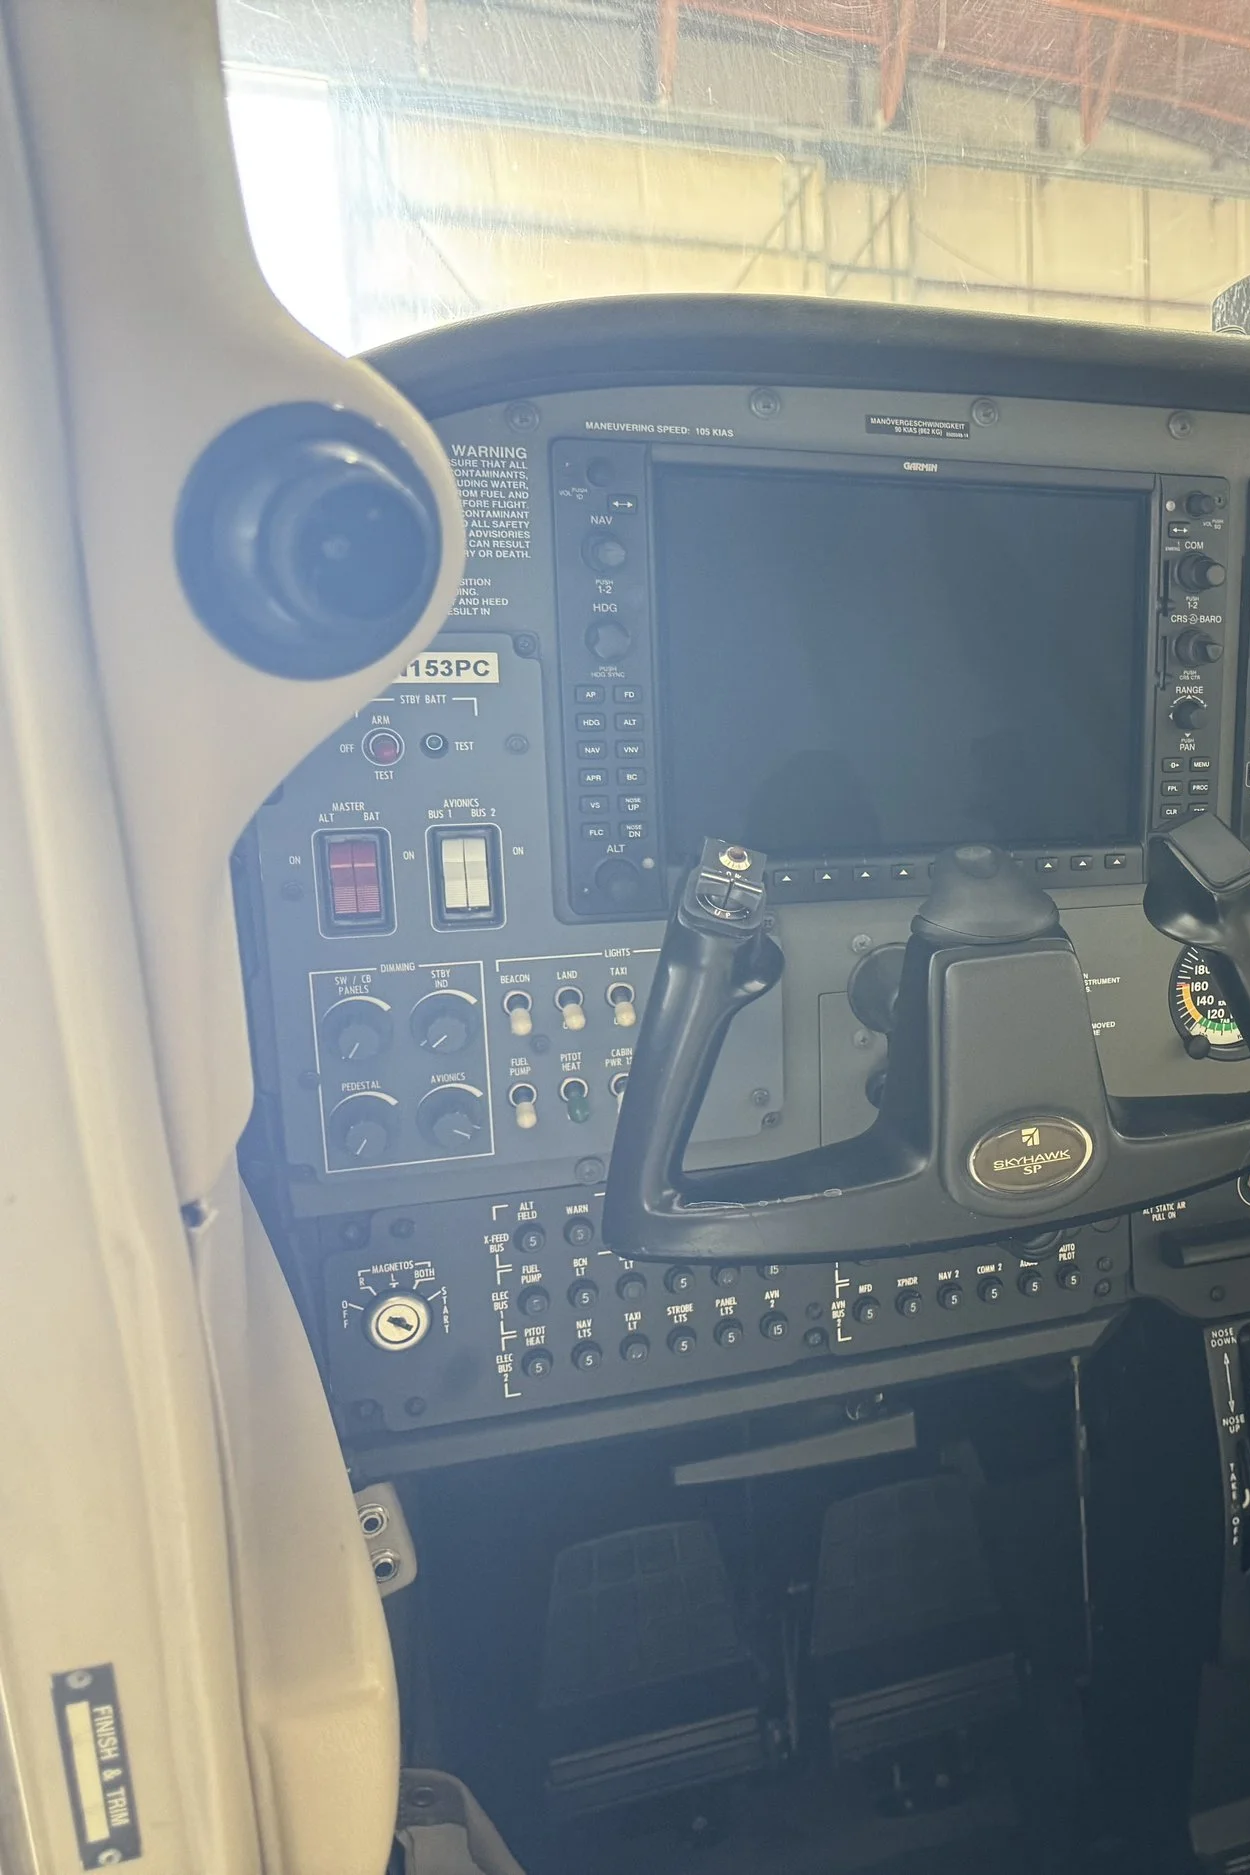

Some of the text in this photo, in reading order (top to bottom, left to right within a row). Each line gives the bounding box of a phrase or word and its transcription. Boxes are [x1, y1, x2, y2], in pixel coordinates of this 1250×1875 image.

[585, 421, 734, 438] MANEUVERING SPEED: 105 KIAS
[452, 444, 527, 459] WARNING
[481, 459, 507, 468] THAT
[509, 460, 528, 469] ALL
[903, 462, 938, 472] GARMIN
[491, 481, 529, 490] WATER,
[481, 490, 529, 499] FUEL AND
[492, 501, 529, 509] FLIGHT.
[472, 520, 530, 529] ALL SAFETY
[591, 516, 613, 525] NAV
[469, 540, 531, 549] CAN RESULT
[479, 550, 492, 558] OR
[496, 550, 531, 559] DEATH.
[459, 598, 508, 606] AND HEED
[480, 608, 490, 616] IN
[593, 603, 617, 612] HDG
[1171, 615, 1222, 623] CRS BARO
[400, 694, 447, 705] STBY BATT
[372, 715, 390, 725] ARM
[339, 744, 355, 752] OFF
[454, 742, 474, 751] TEST
[374, 771, 394, 780] TEST
[332, 802, 365, 812] MASTER
[443, 798, 480, 808] AVIONICS
[318, 812, 380, 823] ALT BAT
[428, 810, 444, 819] BUS
[471, 808, 496, 818] BUS 2
[512, 846, 524, 855] ON
[607, 844, 626, 853] ALT
[289, 856, 301, 864] ON
[403, 851, 415, 860] ON
[604, 948, 631, 958] LIGHTS
[380, 962, 415, 973] DIMMING
[610, 966, 628, 975] TAXI
[431, 969, 450, 978] STBY
[556, 970, 577, 980] LAND
[335, 976, 349, 985] SW
[359, 975, 372, 984] CB
[435, 979, 448, 989] IND
[500, 974, 530, 984] BEACON
[338, 985, 369, 995] PANELS
[1191, 981, 1208, 992] 160
[1196, 995, 1214, 1006] 140
[1208, 1009, 1224, 1019] 120
[560, 1052, 582, 1062] PITOT
[611, 1048, 632, 1057] CABIN
[511, 1058, 528, 1066] FUEL
[562, 1062, 582, 1071] HEAT
[605, 1058, 622, 1067] PWR
[510, 1067, 531, 1076] PUMP
[430, 1072, 466, 1083] AVIONICS
[341, 1080, 381, 1091] PEDESTAL
[994, 1150, 1070, 1169] SKYHAWK
[1024, 1164, 1042, 1175] SP
[520, 1201, 534, 1211] ALT
[566, 1204, 588, 1214] WARN
[1156, 1203, 1174, 1213] STATIC
[1177, 1201, 1186, 1209] AIR
[517, 1211, 537, 1221] FIELD
[1152, 1214, 1165, 1222] PULL
[484, 1233, 509, 1244] X-FEED
[489, 1244, 504, 1253] BUS
[1058, 1243, 1075, 1253] AUTO
[1058, 1251, 1075, 1261] PILOT
[371, 1261, 414, 1273] MAGNETOS
[573, 1258, 588, 1267] BCN
[414, 1268, 435, 1278] BOTH
[522, 1264, 540, 1273] FUEL
[576, 1268, 585, 1276] LT
[977, 1263, 1002, 1275] COMM 2
[521, 1273, 542, 1284] PUMP
[938, 1269, 959, 1280] NAV 2
[359, 1277, 365, 1286] R
[897, 1276, 918, 1287] XPNDR
[858, 1283, 873, 1293] MFD
[492, 1291, 508, 1300] ELEC
[765, 1290, 780, 1300] AVN
[494, 1301, 508, 1311] BUS
[716, 1297, 737, 1308] PANEL
[442, 1286, 450, 1334] START
[667, 1304, 694, 1315] STROBE
[720, 1306, 734, 1316] LTS
[832, 1309, 845, 1319] BUS
[624, 1312, 641, 1321] TAXI
[674, 1314, 688, 1323] LTS
[576, 1319, 592, 1328] NAV
[628, 1321, 637, 1330] LT
[524, 1326, 545, 1337] PITOT
[577, 1329, 592, 1338] LTS
[1212, 1327, 1234, 1338] NOSE
[526, 1336, 545, 1346] HEAT
[1211, 1337, 1237, 1347] DOWN
[496, 1354, 513, 1363] ELEC
[498, 1363, 512, 1373] BUS
[1222, 1414, 1245, 1426] NOSE
[1229, 1463, 1240, 1546] TAKE OFF
[92, 1705, 130, 1827] FINISH & TRIM
